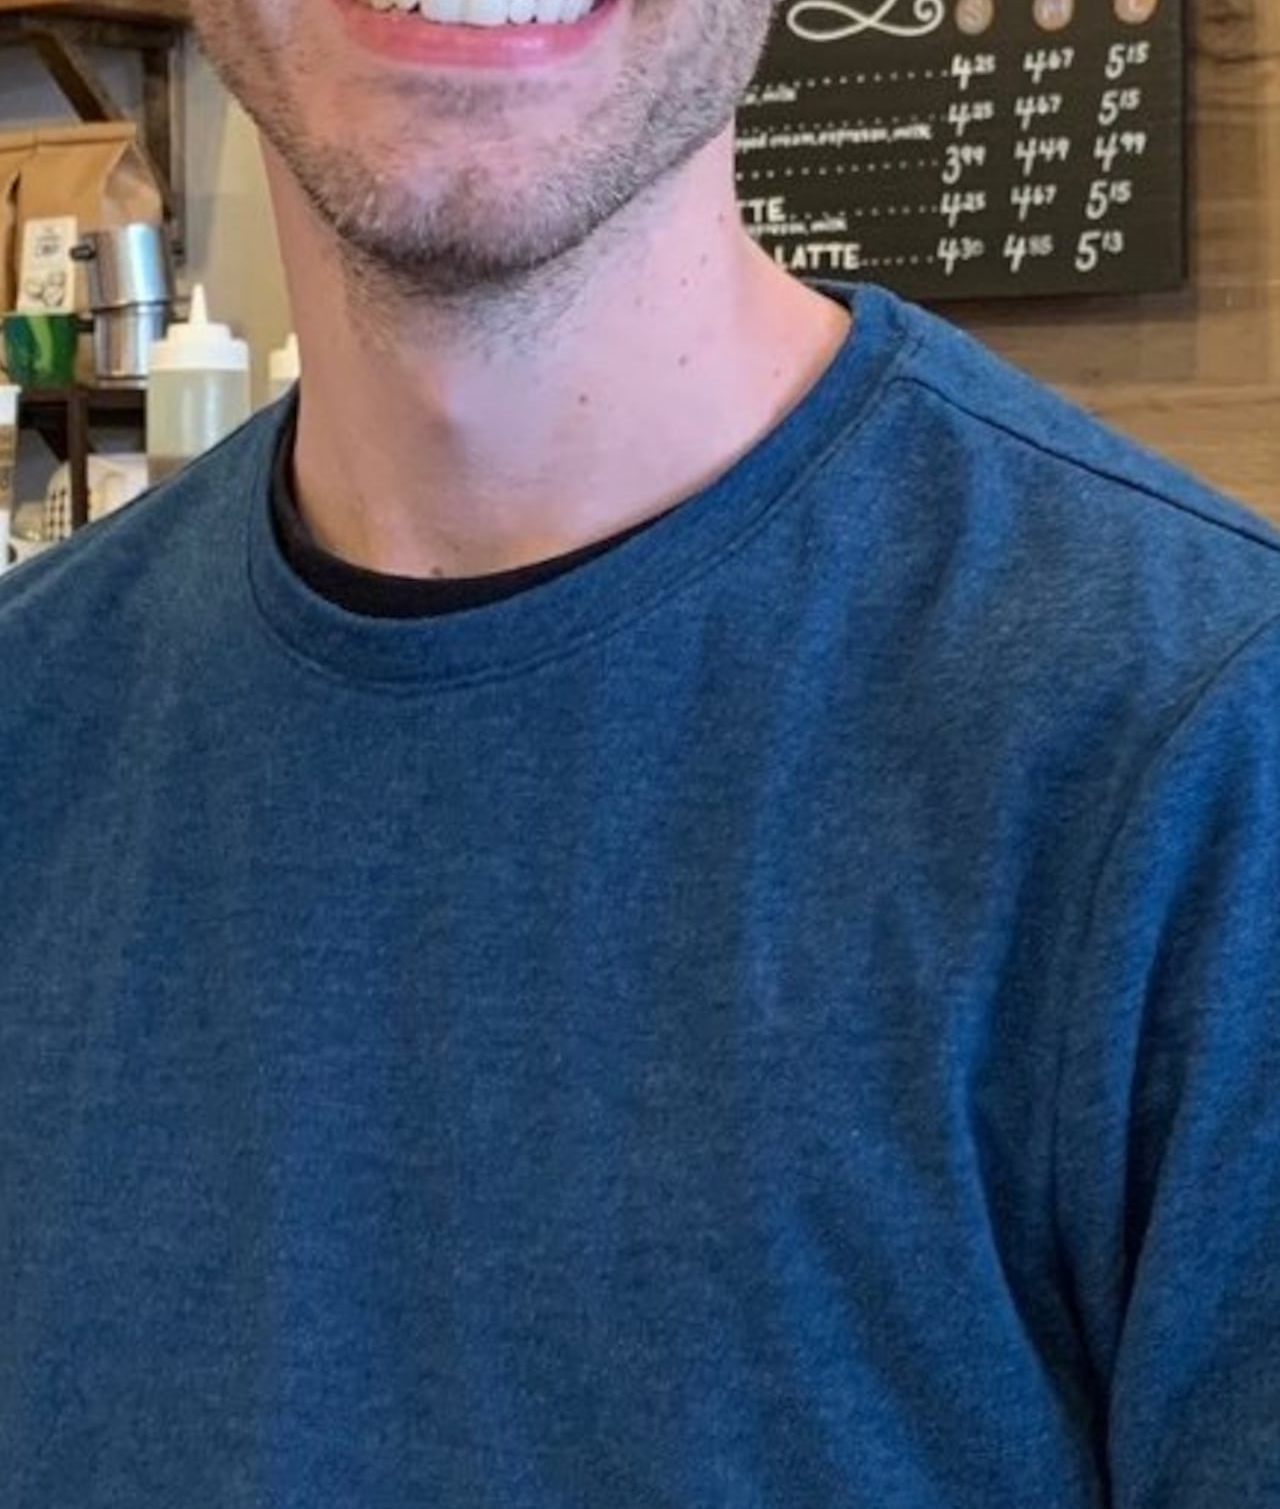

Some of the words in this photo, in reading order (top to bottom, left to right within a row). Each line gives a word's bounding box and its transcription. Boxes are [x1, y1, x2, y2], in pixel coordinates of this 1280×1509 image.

[950, 52, 998, 92] 425
[1022, 46, 1076, 85] 467
[1103, 40, 1152, 81] 515
[947, 100, 995, 138] 425
[1013, 93, 1063, 132] 467
[1097, 87, 1142, 126] 515
[1013, 136, 1071, 178] 449
[1092, 131, 1148, 173] 499
[939, 190, 988, 229] 425
[1009, 183, 1058, 223] 467
[1084, 179, 1133, 221] 515
[773, 242, 861, 270] LATTE
